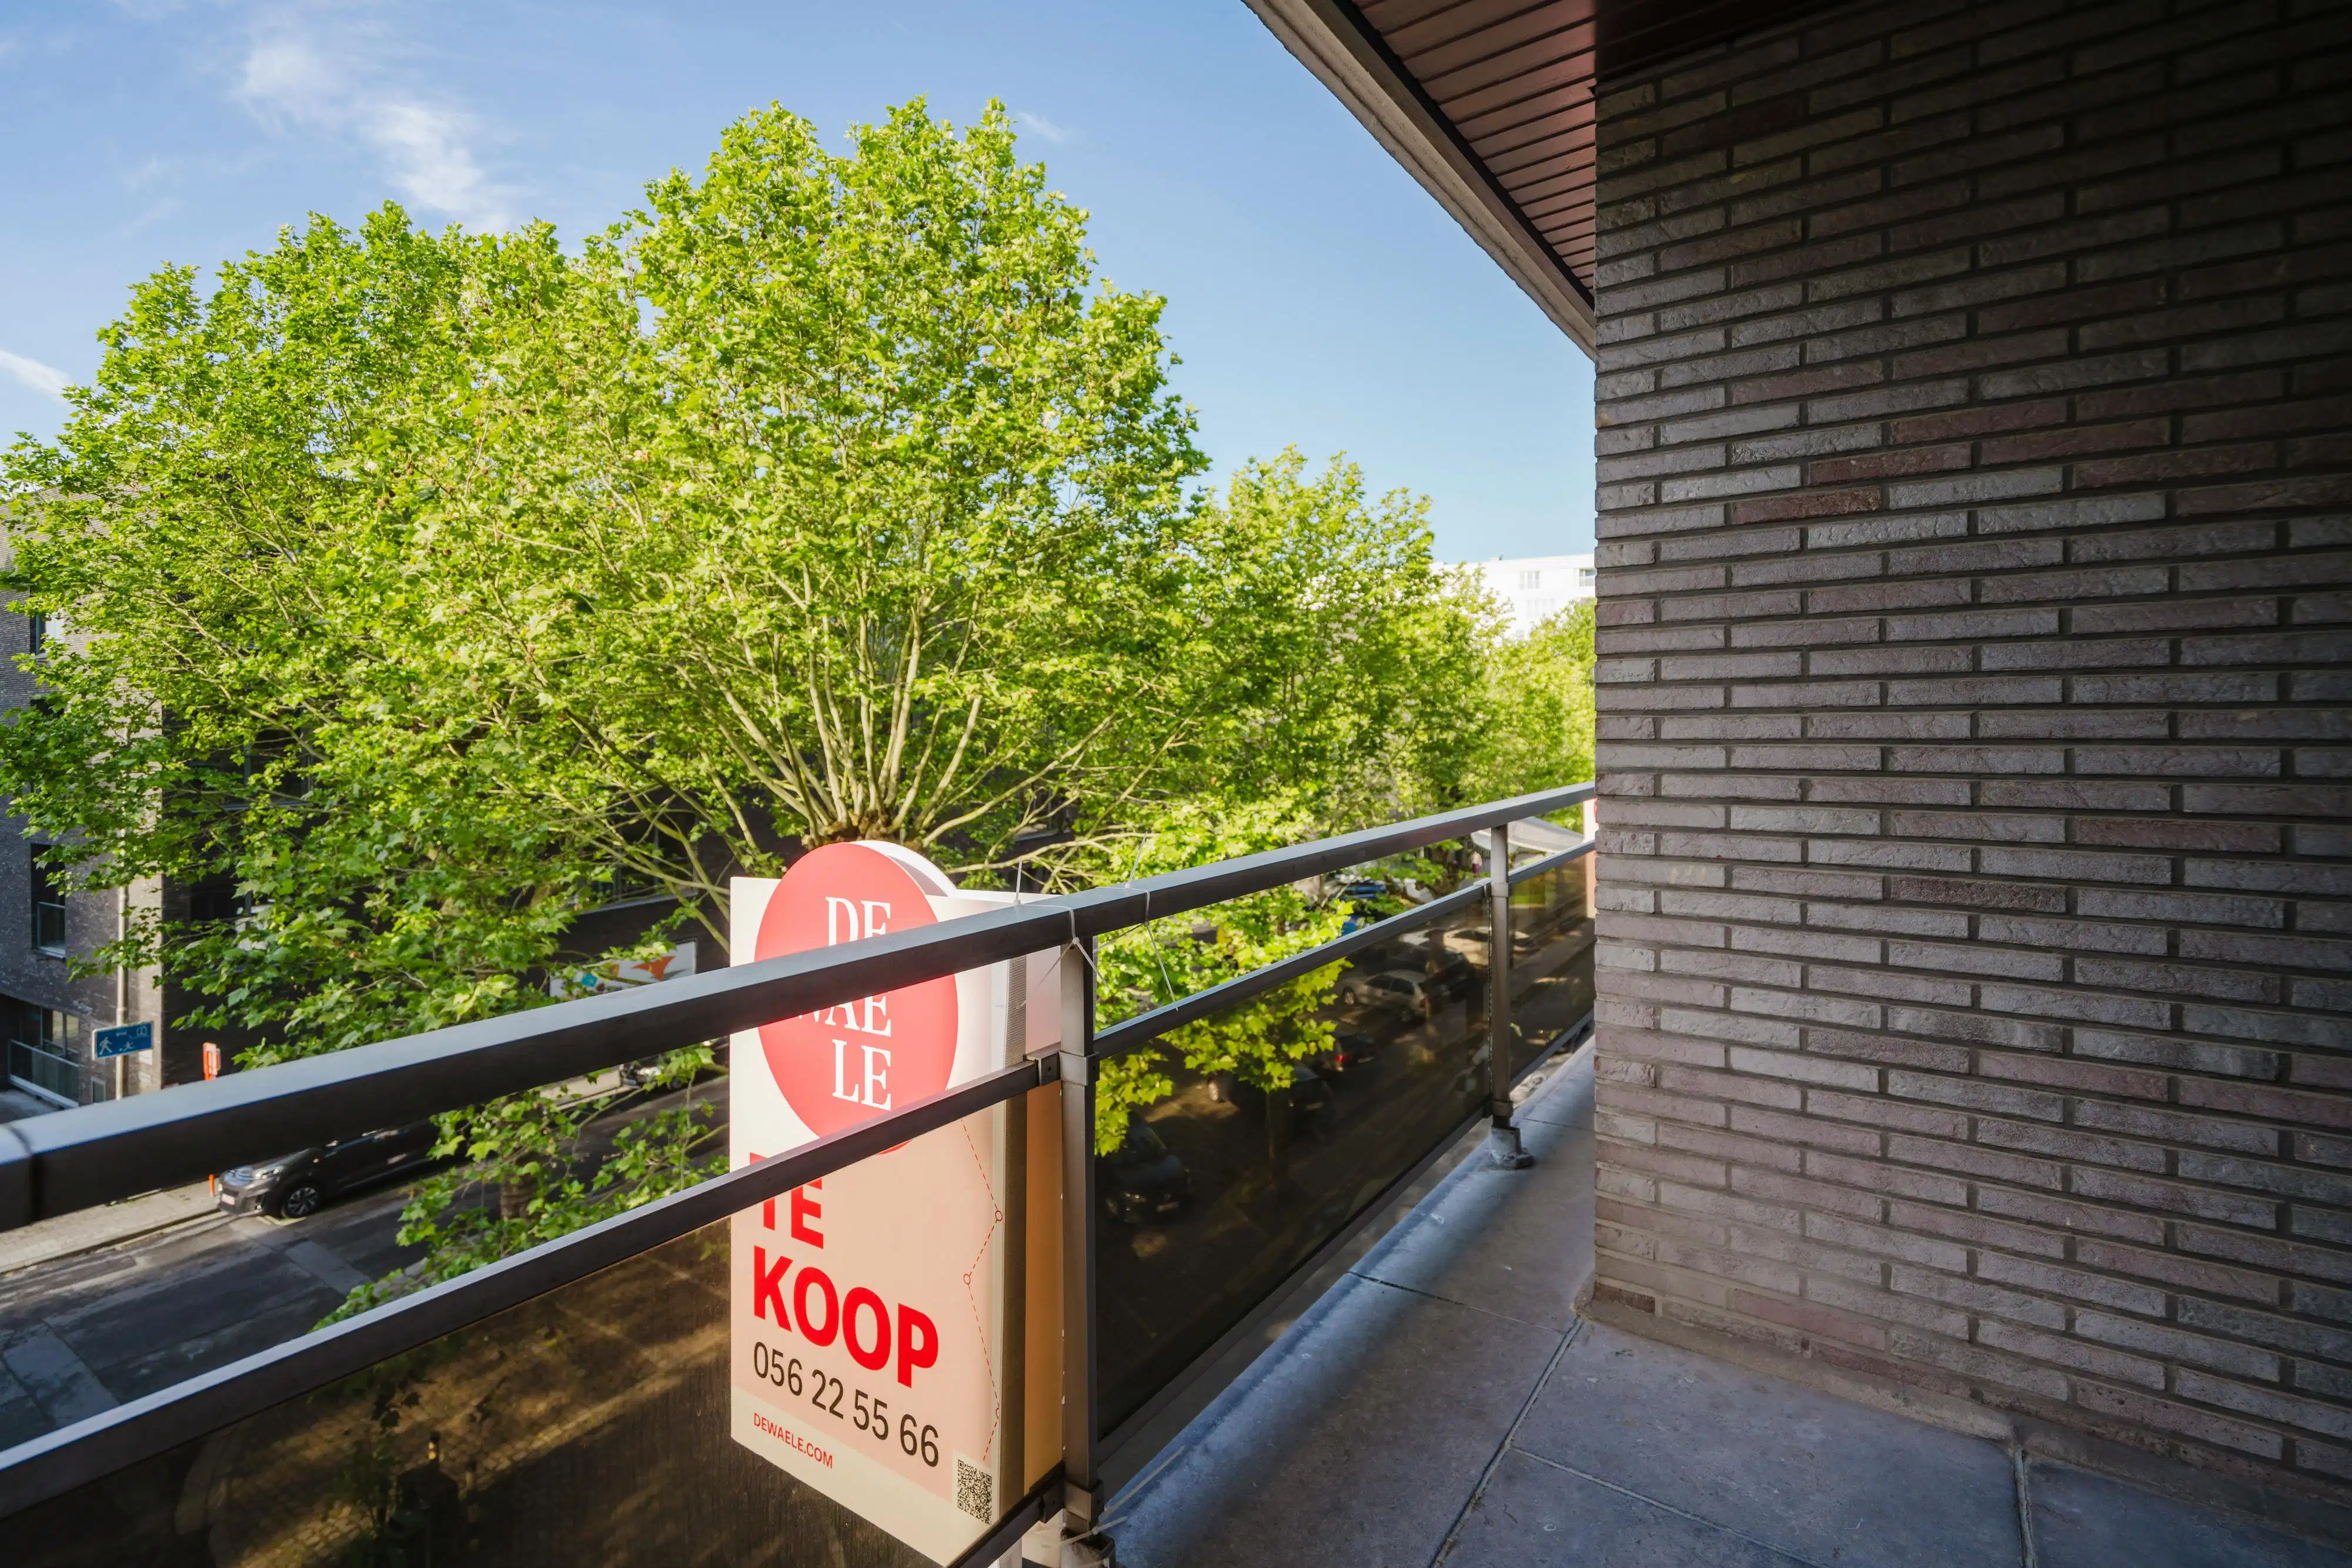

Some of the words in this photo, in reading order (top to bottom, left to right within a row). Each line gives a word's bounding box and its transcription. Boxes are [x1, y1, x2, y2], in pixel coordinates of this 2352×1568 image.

[825, 896, 891, 947] DE
[832, 1039, 891, 1111] LE
[754, 1245, 939, 1389] KOOP
[753, 1412, 833, 1469] DEWAELE.COM
[754, 1342, 803, 1396] 056
[811, 1369, 844, 1420] 22
[853, 1388, 888, 1440] 55
[900, 1413, 939, 1467] 66
